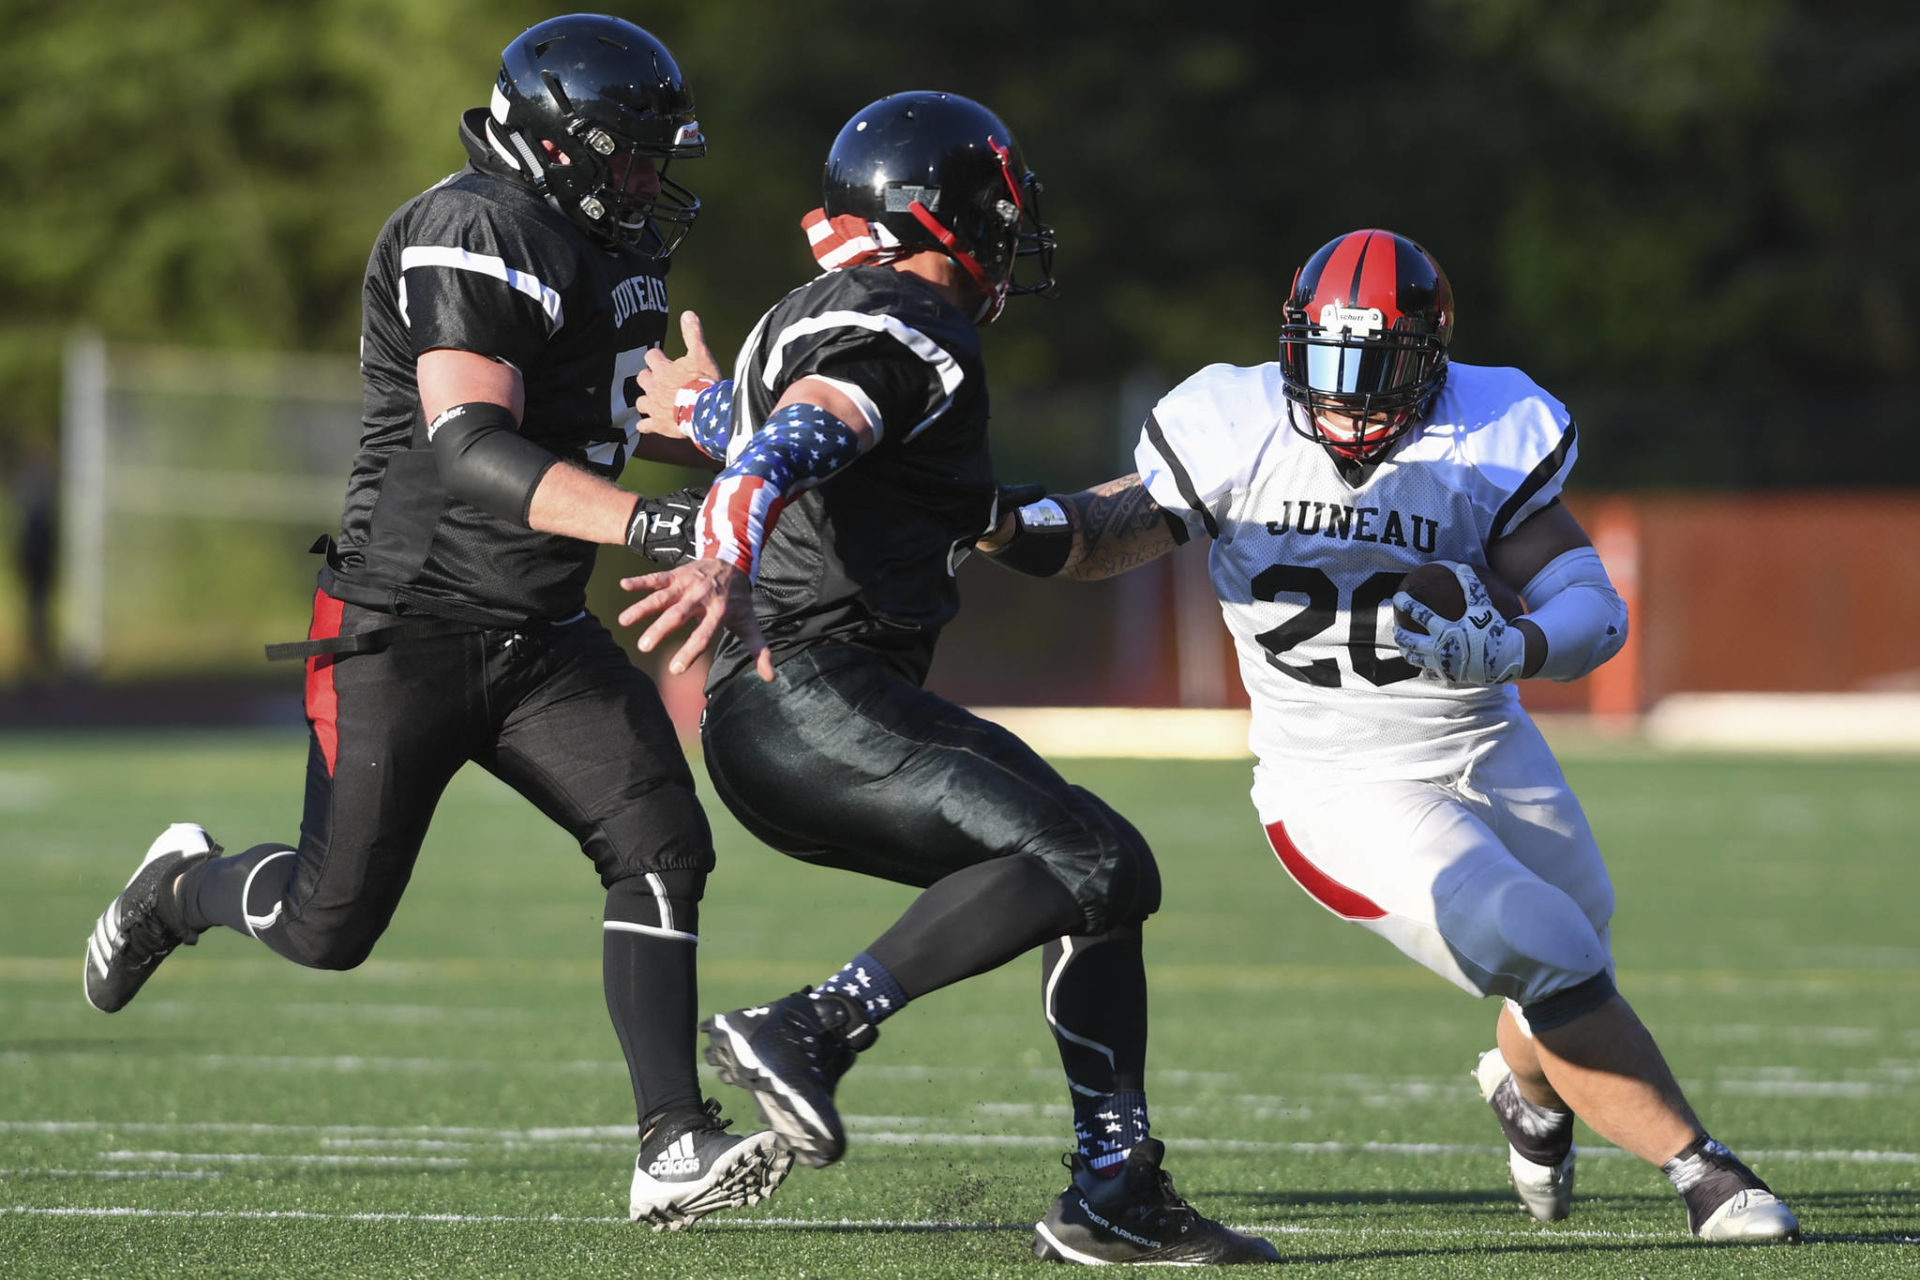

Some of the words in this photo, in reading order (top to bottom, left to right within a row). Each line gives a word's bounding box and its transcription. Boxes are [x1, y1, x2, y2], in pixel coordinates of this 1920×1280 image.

[1266, 500, 1439, 553] JUNEAU
[1251, 563, 1423, 687] 20
[648, 1157, 700, 1176] adidas
[1079, 1198, 1110, 1229] UNDER
[1110, 1225, 1162, 1249] ARMOUR
